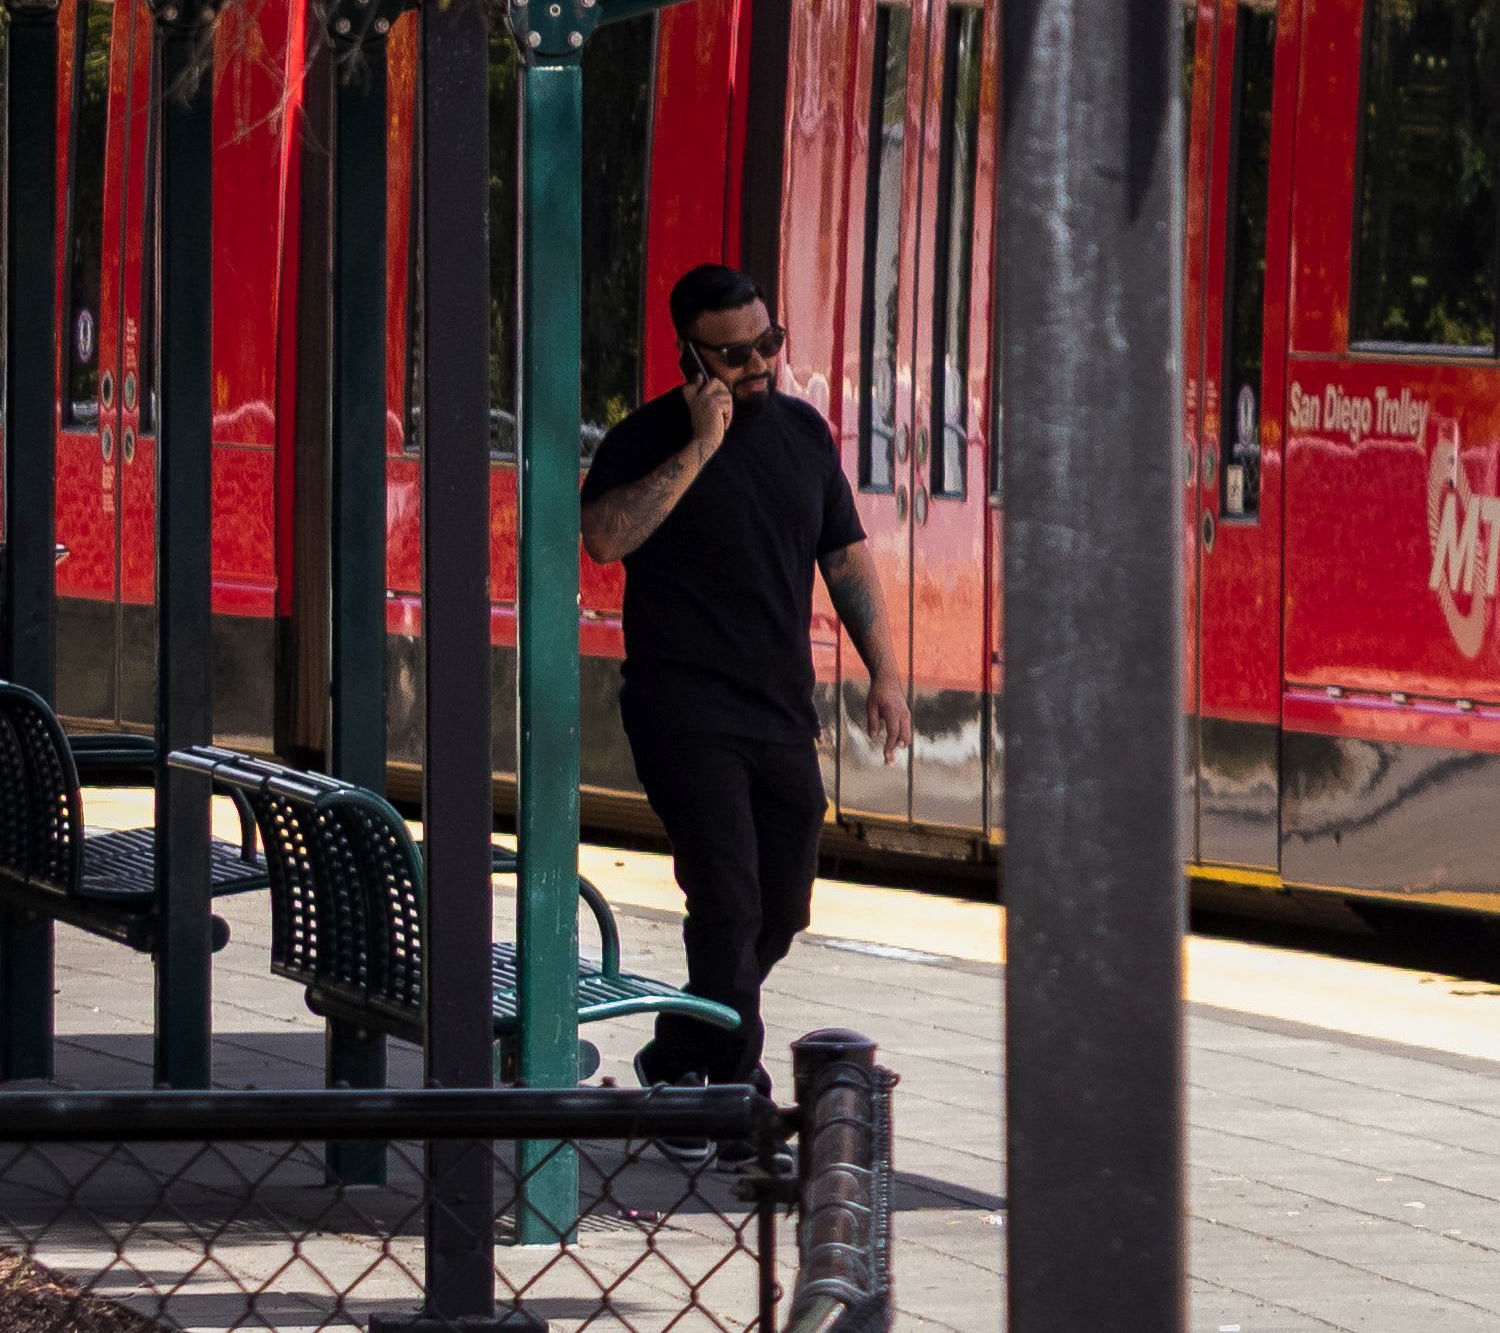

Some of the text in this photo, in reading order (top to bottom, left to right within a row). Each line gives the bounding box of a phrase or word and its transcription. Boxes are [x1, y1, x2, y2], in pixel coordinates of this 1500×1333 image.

[1289, 381, 1321, 430] San
[1323, 383, 1372, 445] Diego
[1374, 385, 1430, 446] Trolley
